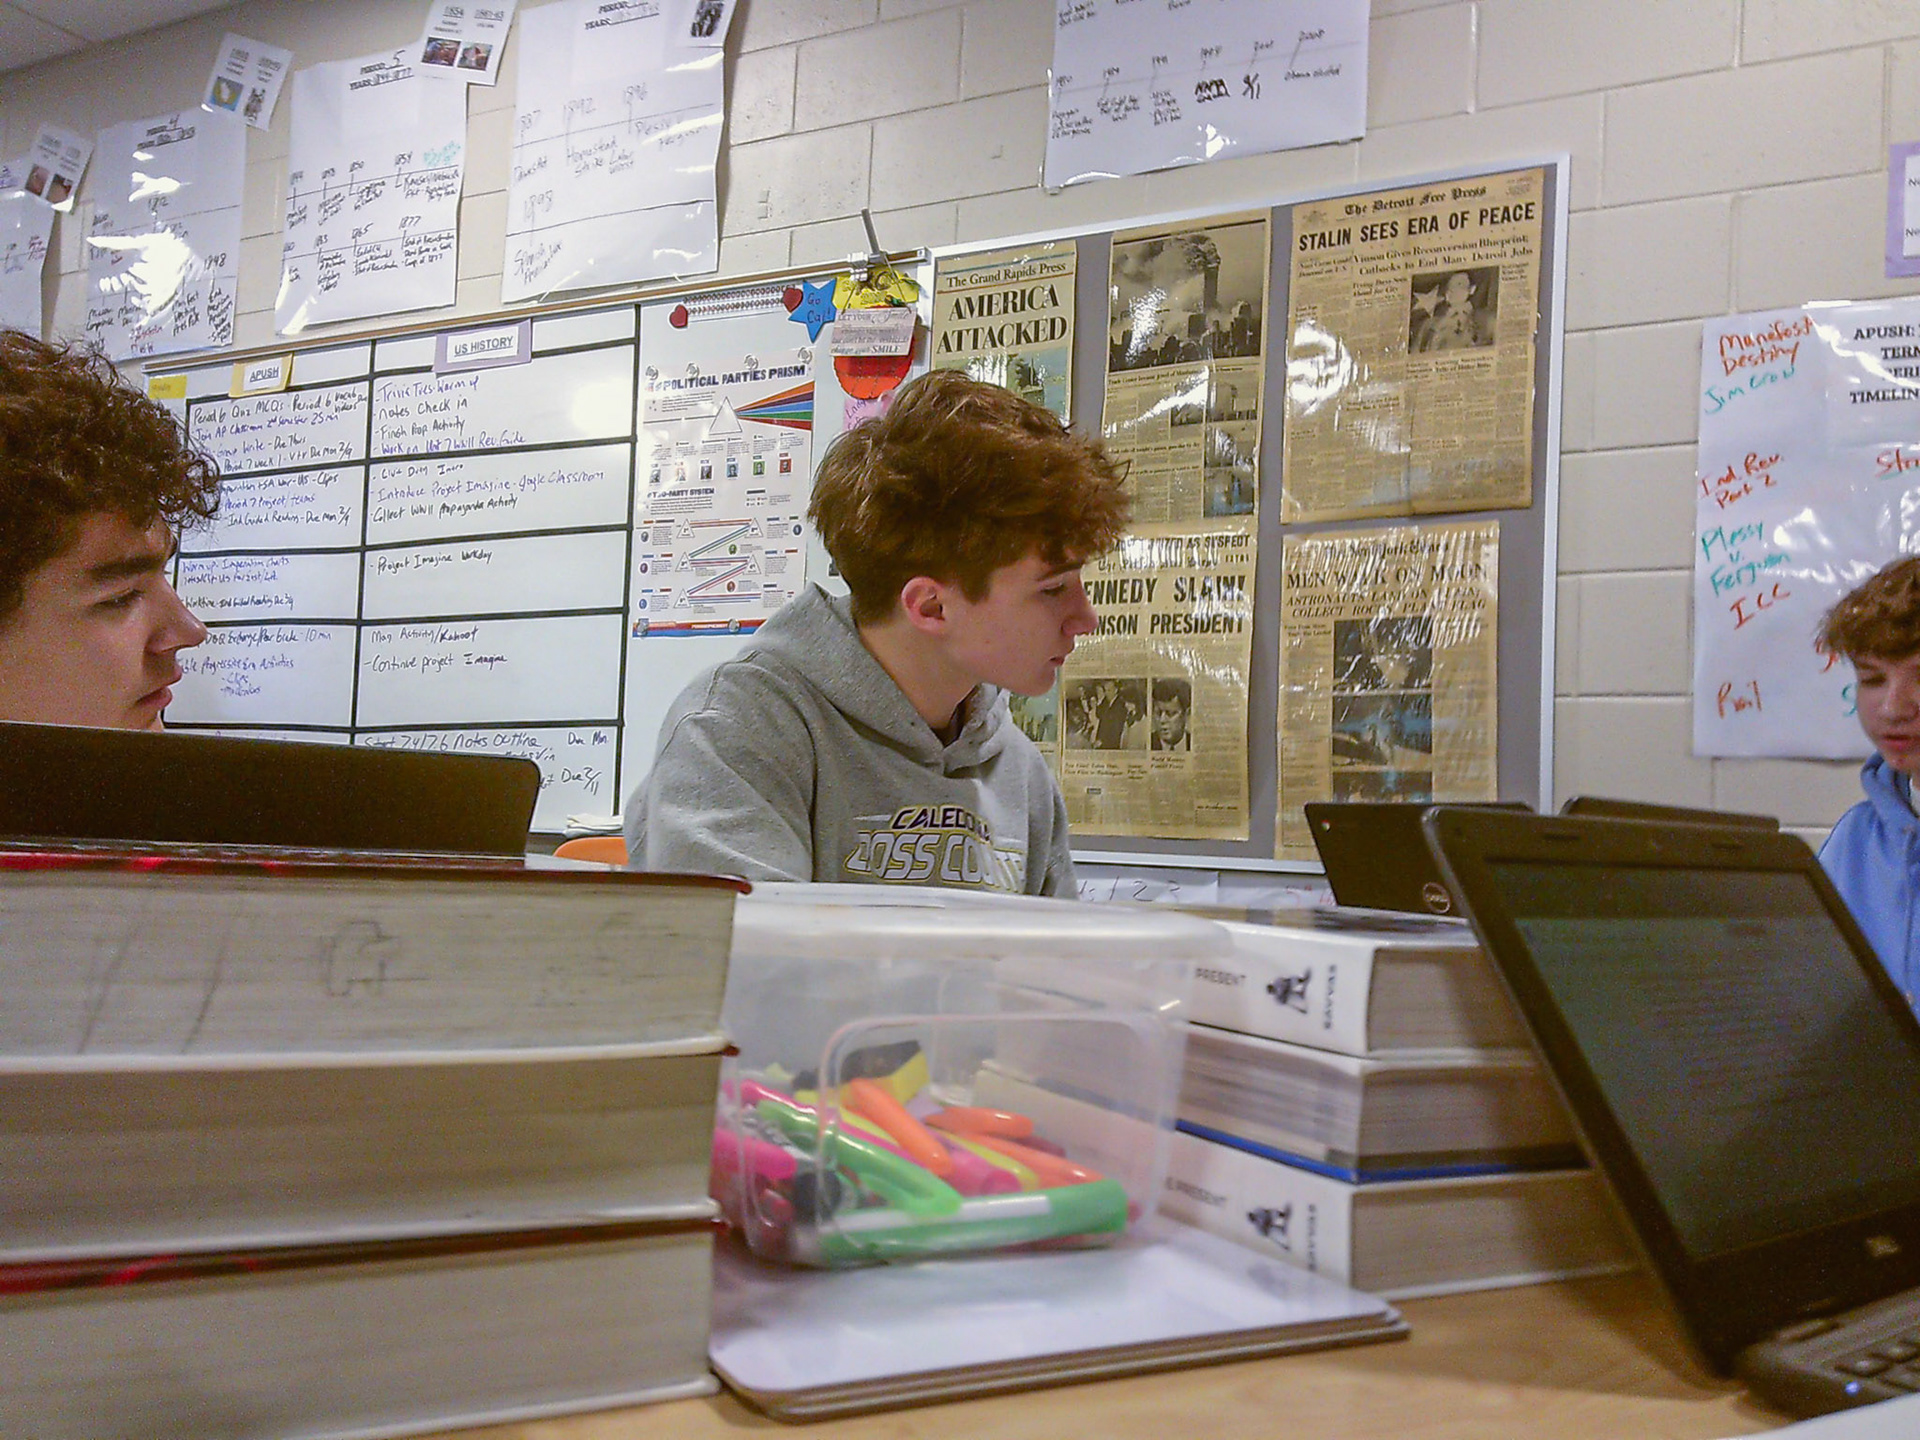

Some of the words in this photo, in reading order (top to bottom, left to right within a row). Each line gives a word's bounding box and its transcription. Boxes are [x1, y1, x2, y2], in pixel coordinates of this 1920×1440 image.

[1345, 203, 1368, 216] The
[1372, 197, 1415, 213] Detroit
[1419, 191, 1447, 206] Free
[1452, 185, 1488, 201] Press
[1299, 227, 1352, 251] STALIN
[1360, 220, 1399, 242] SEES
[1407, 214, 1440, 235] ERA
[1449, 211, 1470, 230] OF
[1479, 202, 1536, 225] PEACE
[1418, 258, 1438, 269] End
[1472, 250, 1507, 262] Detroit
[947, 276, 966, 288] The
[970, 270, 1001, 285] Grand
[1004, 265, 1036, 282] Rapids
[1039, 262, 1066, 274] Press
[807, 293, 821, 305] Go
[949, 284, 1060, 321] AMERICA
[936, 316, 1068, 355] ATTACKED
[1854, 324, 1916, 341] APUSH:
[454, 344, 468, 357] US
[470, 336, 514, 353] HISTORY
[871, 344, 900, 354] SMILE
[250, 367, 279, 383] APUSH
[663, 374, 720, 391] POLITICAL
[722, 368, 766, 385] PARTIES
[769, 364, 806, 380] PRISM
[293, 394, 320, 411] Period
[456, 394, 468, 409] in
[1704, 384, 1745, 415] Jim
[1850, 387, 1920, 405] TIMELIN
[215, 426, 226, 439] AP
[652, 487, 689, 499] TO-PARTY
[377, 555, 409, 575] Project
[413, 554, 453, 569] Imagine
[1287, 572, 1326, 589] MEN
[1084, 578, 1158, 605] ENNEDY
[1094, 614, 1138, 636] NSON
[1150, 612, 1244, 634] PRESIDENT
[562, 768, 582, 783] Due
[892, 807, 991, 842] CALEDO
[1196, 967, 1246, 987] PRESENT
